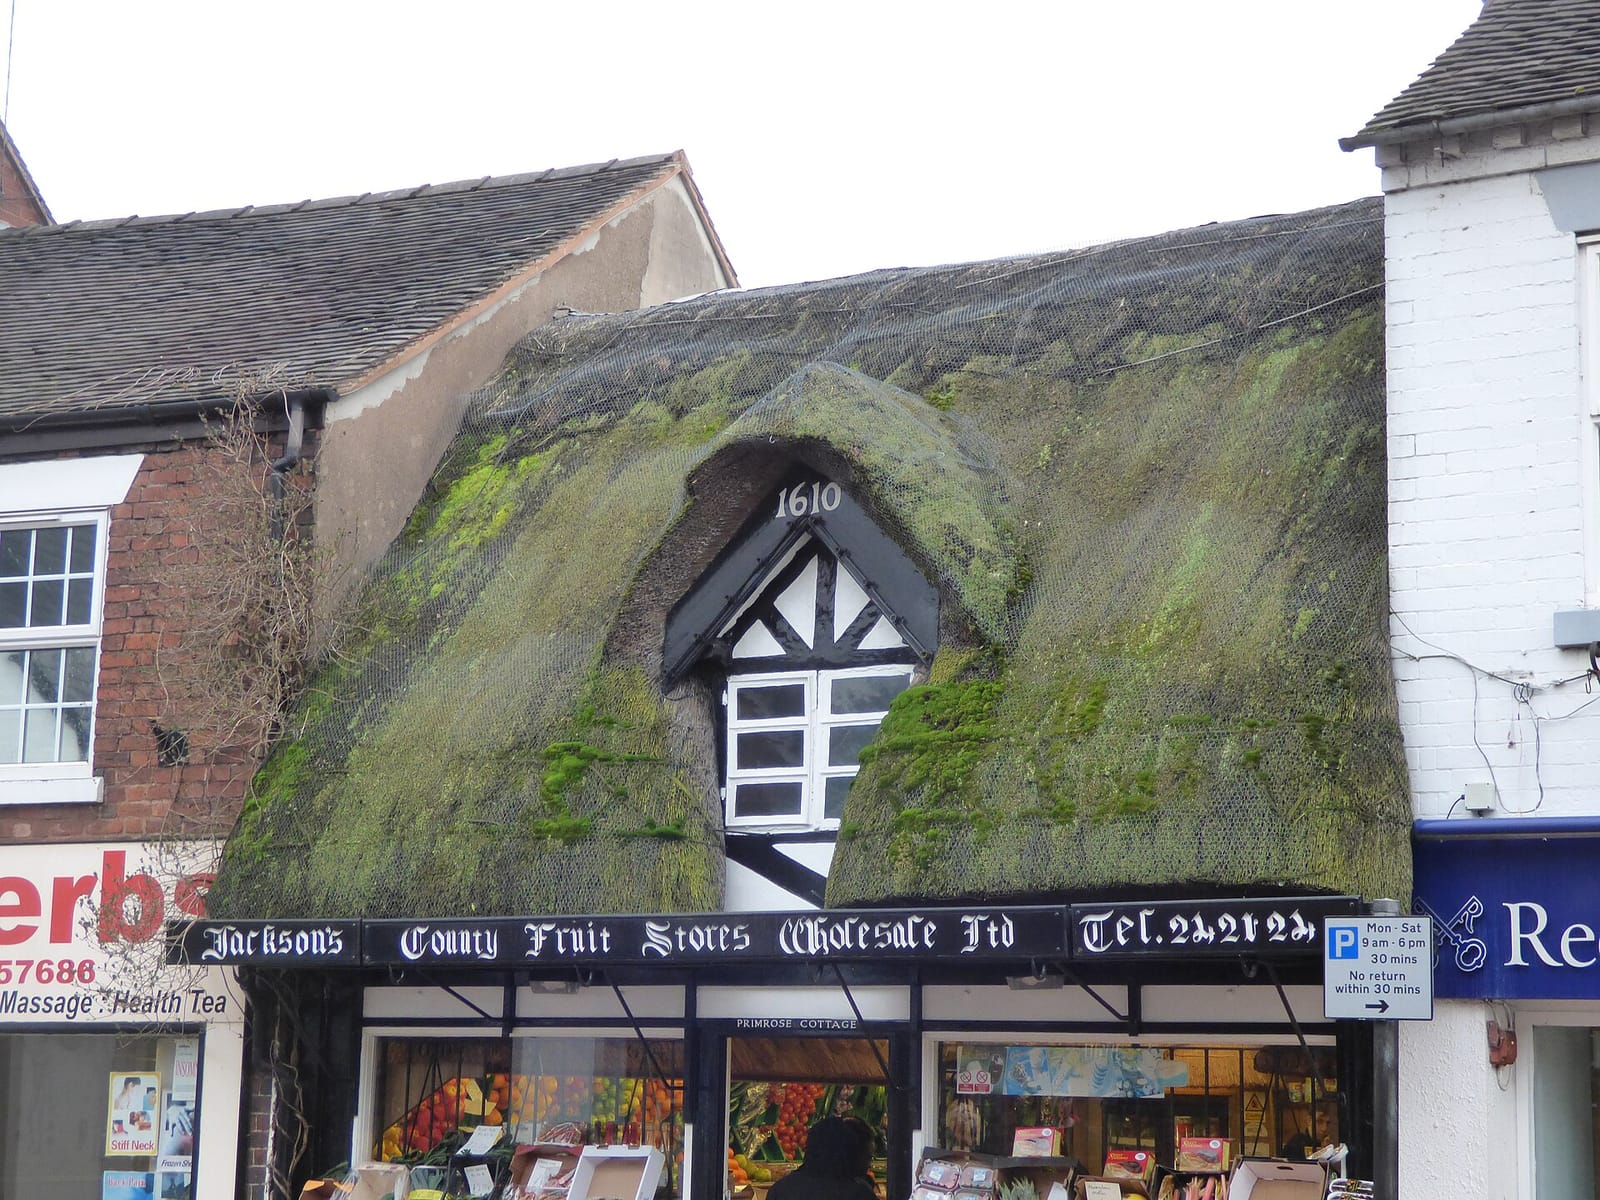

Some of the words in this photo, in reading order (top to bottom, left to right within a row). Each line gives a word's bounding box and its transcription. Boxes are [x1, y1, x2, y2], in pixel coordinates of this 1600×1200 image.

[775, 481, 842, 518] 1610
[1367, 923, 1391, 933] Mon
[1401, 923, 1421, 933] Sat
[201, 924, 344, 960] Jackson's
[400, 924, 498, 960] County
[524, 920, 611, 957] Fruit
[641, 920, 750, 957] Stores
[779, 915, 937, 955] Wholesale
[960, 912, 1015, 954] Ltd
[1502, 902, 1600, 968] Re
[1335, 929, 1355, 958] P
[1371, 953, 1387, 964] 30
[1390, 953, 1418, 964] mins
[1349, 970, 1365, 981] No
[1369, 970, 1406, 981] return
[1335, 983, 1370, 994] within
[1374, 983, 1391, 994] 30
[1393, 983, 1421, 994] mins
[0, 990, 93, 1019] Massage
[112, 989, 182, 1014] Health
[191, 989, 227, 1014] Tea
[736, 1019, 792, 1029] PRIMROSE
[799, 1020, 857, 1029] COTTAGE
[111, 1140, 130, 1151] Stiff
[131, 1140, 155, 1151] Neck
